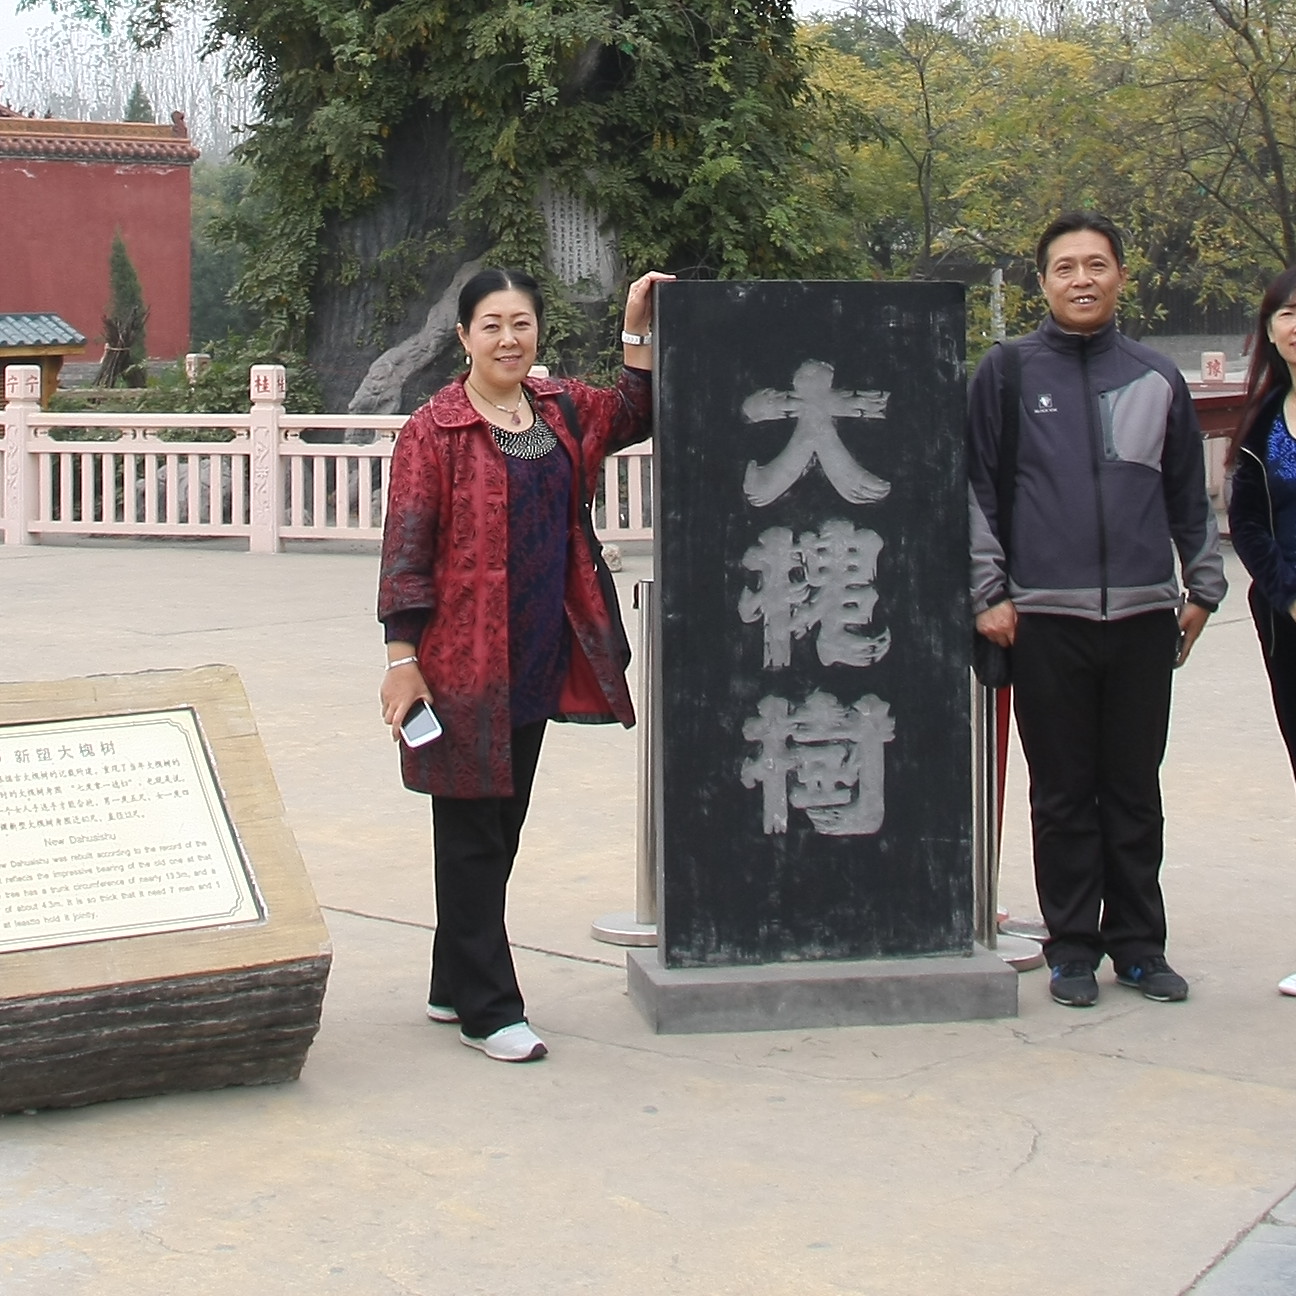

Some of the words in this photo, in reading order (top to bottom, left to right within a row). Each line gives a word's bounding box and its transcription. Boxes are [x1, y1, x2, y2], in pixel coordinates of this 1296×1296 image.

[1206, 359, 1222, 378] 豫
[6, 374, 19, 394] 宁
[25, 374, 39, 394] 宁
[254, 374, 271, 394] 桂
[738, 358, 897, 837] 大槐樹
[13, 740, 115, 763] 新塑大槐树
[43, 838, 64, 846] New
